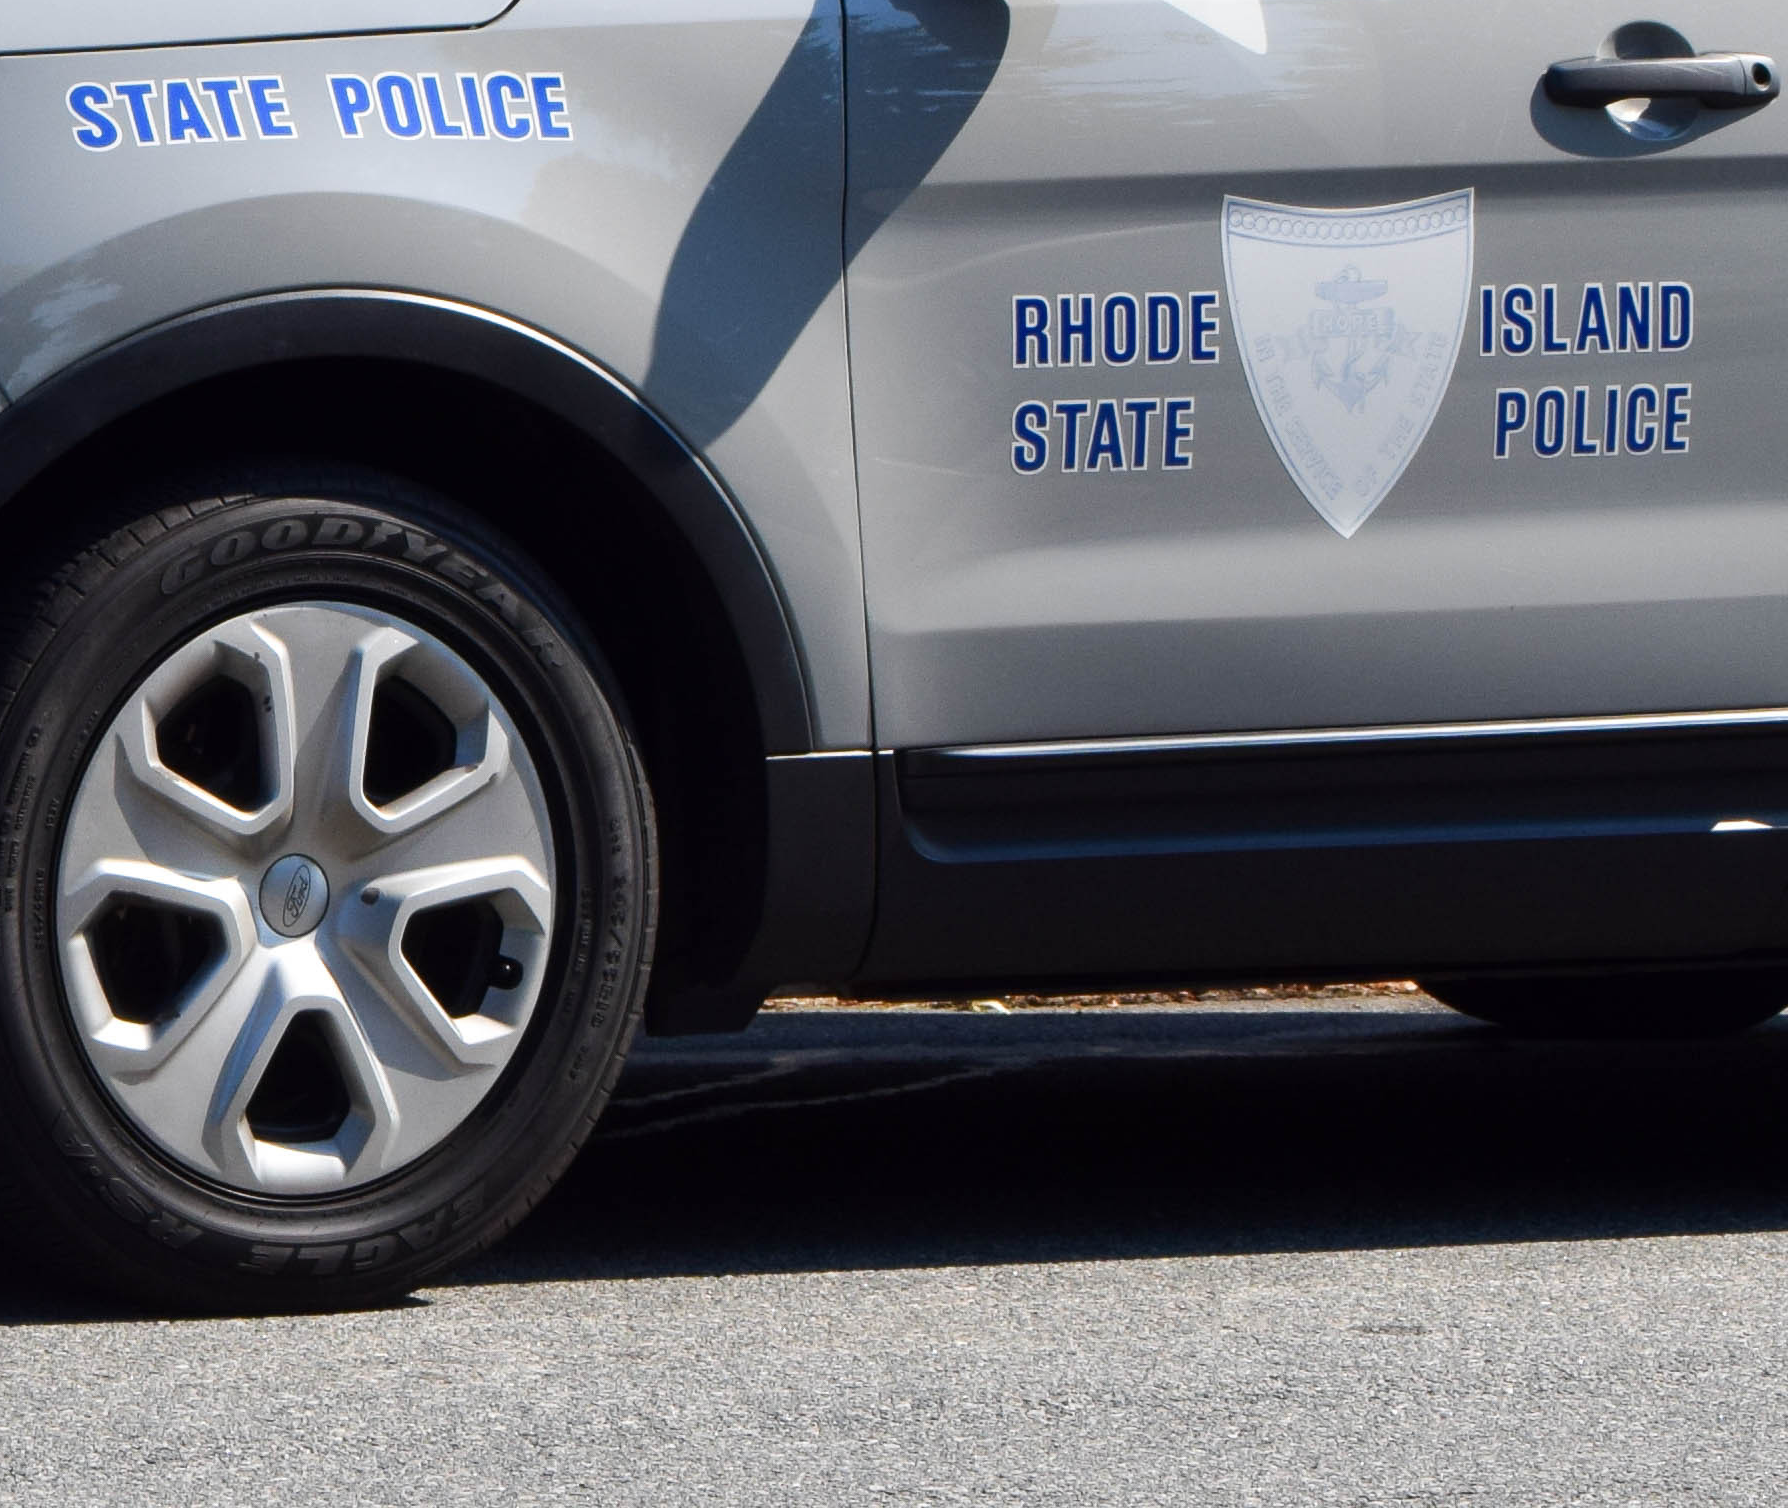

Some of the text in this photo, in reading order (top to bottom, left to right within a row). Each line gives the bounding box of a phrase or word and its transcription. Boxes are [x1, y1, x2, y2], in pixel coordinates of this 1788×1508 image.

[65, 70, 574, 152] STATE POLICE
[1012, 281, 1694, 369] RHODE ISLAND
[1012, 383, 1692, 475] STATE POLICE
[159, 514, 570, 674] GOODYEAR
[286, 874, 309, 919] Ford
